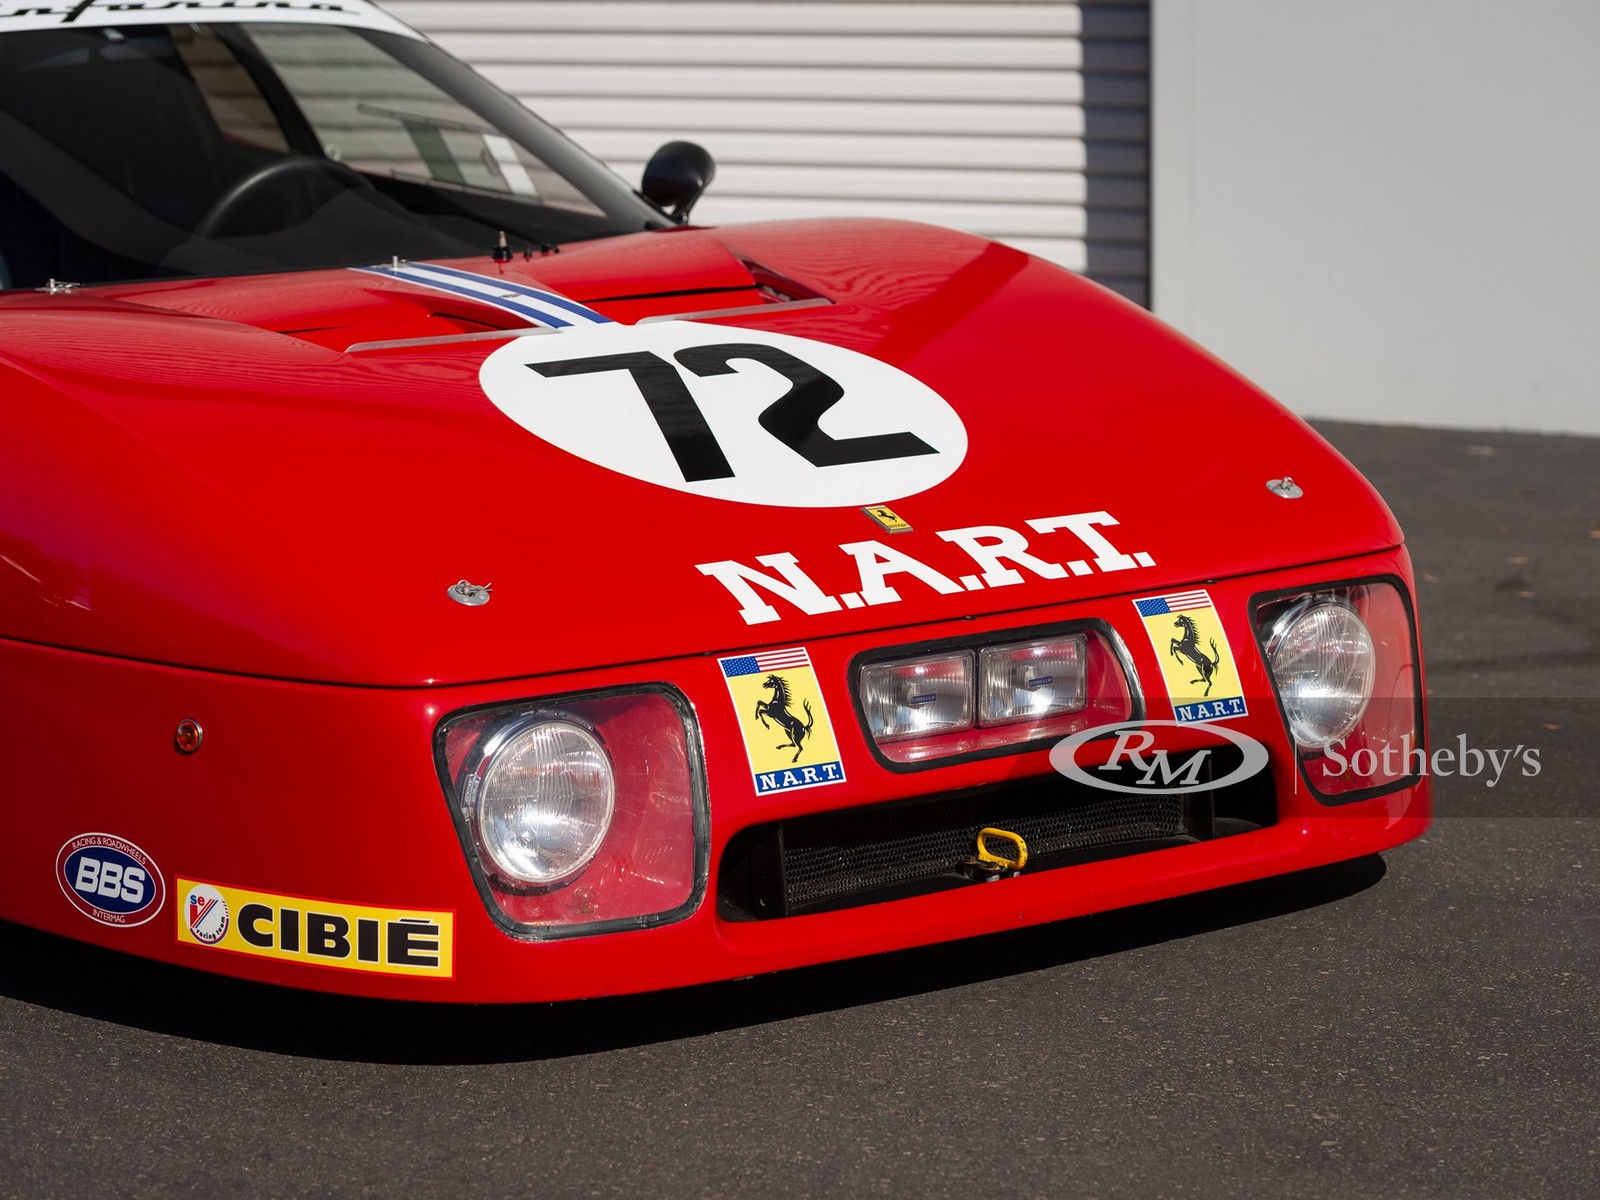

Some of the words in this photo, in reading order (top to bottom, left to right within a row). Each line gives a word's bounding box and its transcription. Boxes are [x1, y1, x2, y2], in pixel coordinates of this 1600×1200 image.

[523, 343, 940, 483] 72
[694, 510, 1157, 626] N.A.R.T.
[1178, 699, 1243, 721] N.A.R.T.
[760, 764, 840, 790] N.A.R.T.
[71, 837, 96, 850] RACING
[97, 837, 102, 845] &
[102, 837, 147, 865] ROADWHEELS
[75, 856, 146, 904] BBS
[92, 908, 126, 923] INTERMAG
